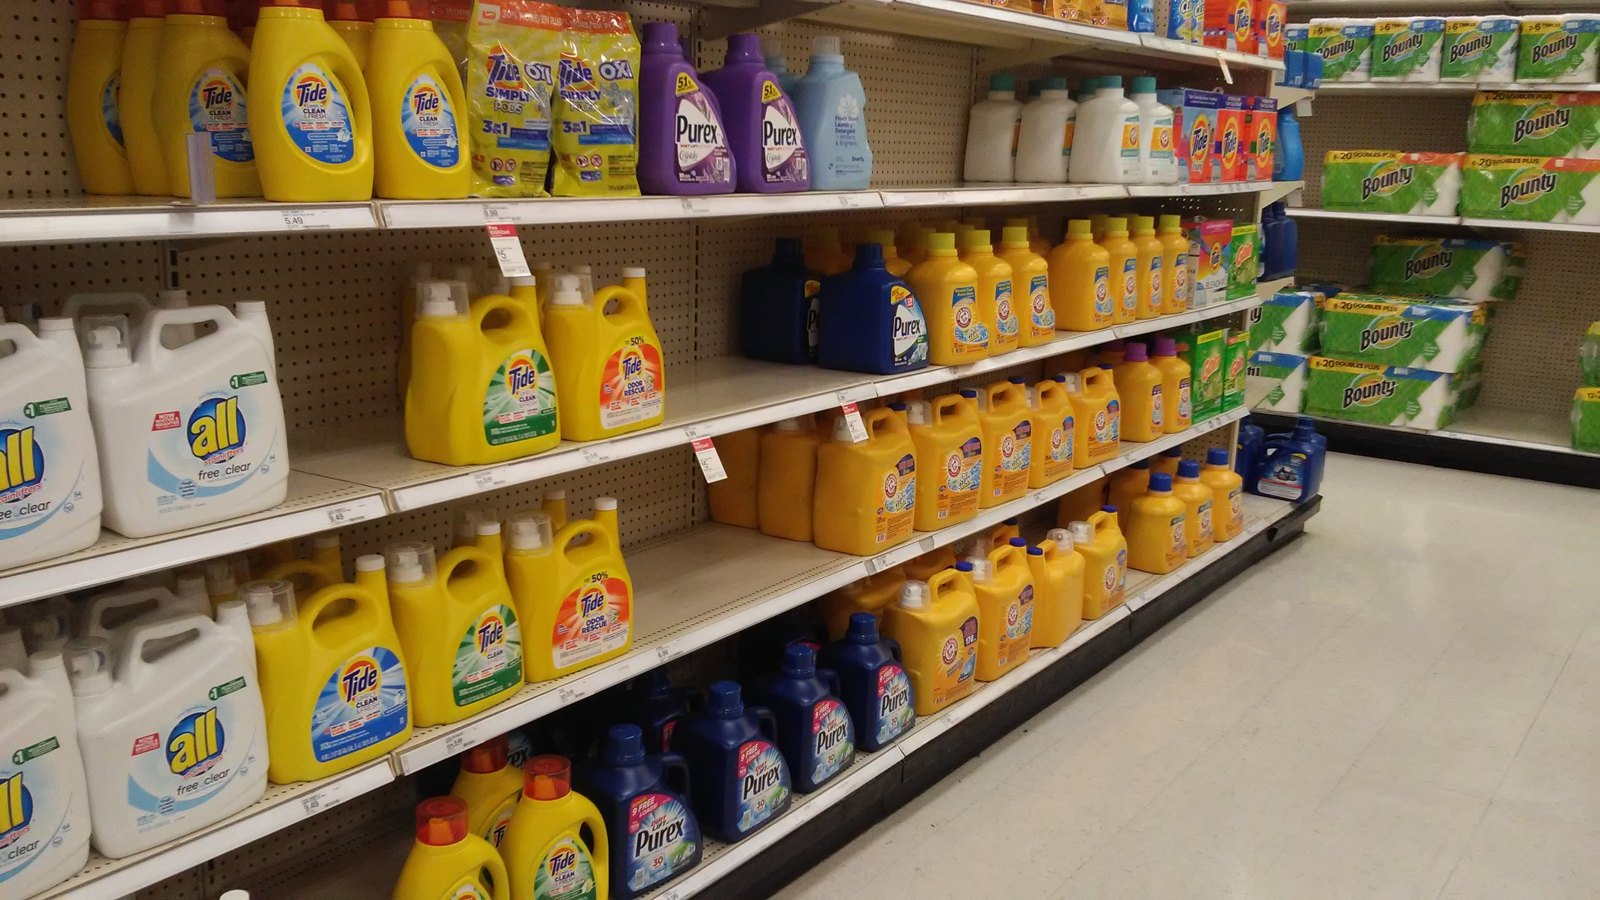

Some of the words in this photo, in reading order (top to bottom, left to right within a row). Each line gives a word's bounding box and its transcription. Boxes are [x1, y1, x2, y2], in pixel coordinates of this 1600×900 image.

[1383, 34, 1423, 62] Bounty
[1450, 34, 1492, 63] Bounty
[1532, 34, 1577, 64] Bounty
[487, 54, 521, 85] Tide
[560, 59, 593, 88] Tide
[203, 86, 232, 109] Tide
[296, 80, 327, 107] Tide
[414, 93, 439, 115] Tide
[486, 87, 530, 102] SIMPLY
[494, 101, 524, 114] PODS
[677, 115, 717, 144] Purex
[764, 121, 797, 146] Purex
[1513, 109, 1570, 143] Bounty
[1362, 167, 1413, 200] Bounty
[1500, 174, 1556, 208] Bounty
[284, 217, 304, 225] 5.49
[1405, 251, 1452, 280] Bounty
[894, 317, 921, 338] Purex
[1361, 321, 1413, 351] Bounty
[631, 336, 645, 346] 50%
[509, 366, 535, 395] Tide
[622, 356, 642, 380] Tide
[624, 386, 646, 396] RESCUE
[627, 380, 643, 389] ODOR
[1343, 380, 1396, 409] Bounty
[190, 395, 239, 458] all
[198, 468, 220, 480] free
[226, 461, 251, 475] clear
[20, 500, 51, 515] clear
[592, 571, 609, 582] 50%
[581, 593, 604, 618] Tide
[582, 620, 608, 634] RESCUE
[586, 614, 605, 626] ODOR
[478, 622, 503, 653] Tide
[343, 666, 377, 703] Tide
[356, 696, 378, 709] CLEAN
[882, 688, 908, 716] Purex
[169, 706, 217, 774] all
[817, 723, 847, 754] Purex
[177, 782, 199, 796] free
[204, 769, 230, 786] clear
[743, 764, 780, 800] Purex
[632, 807, 637, 816] 9
[638, 796, 655, 812] FREE
[8, 839, 40, 860] clear
[635, 818, 684, 858] Purex
[550, 851, 575, 876] Tide
[653, 856, 663, 867] 30
[555, 871, 575, 883] CLEAN
